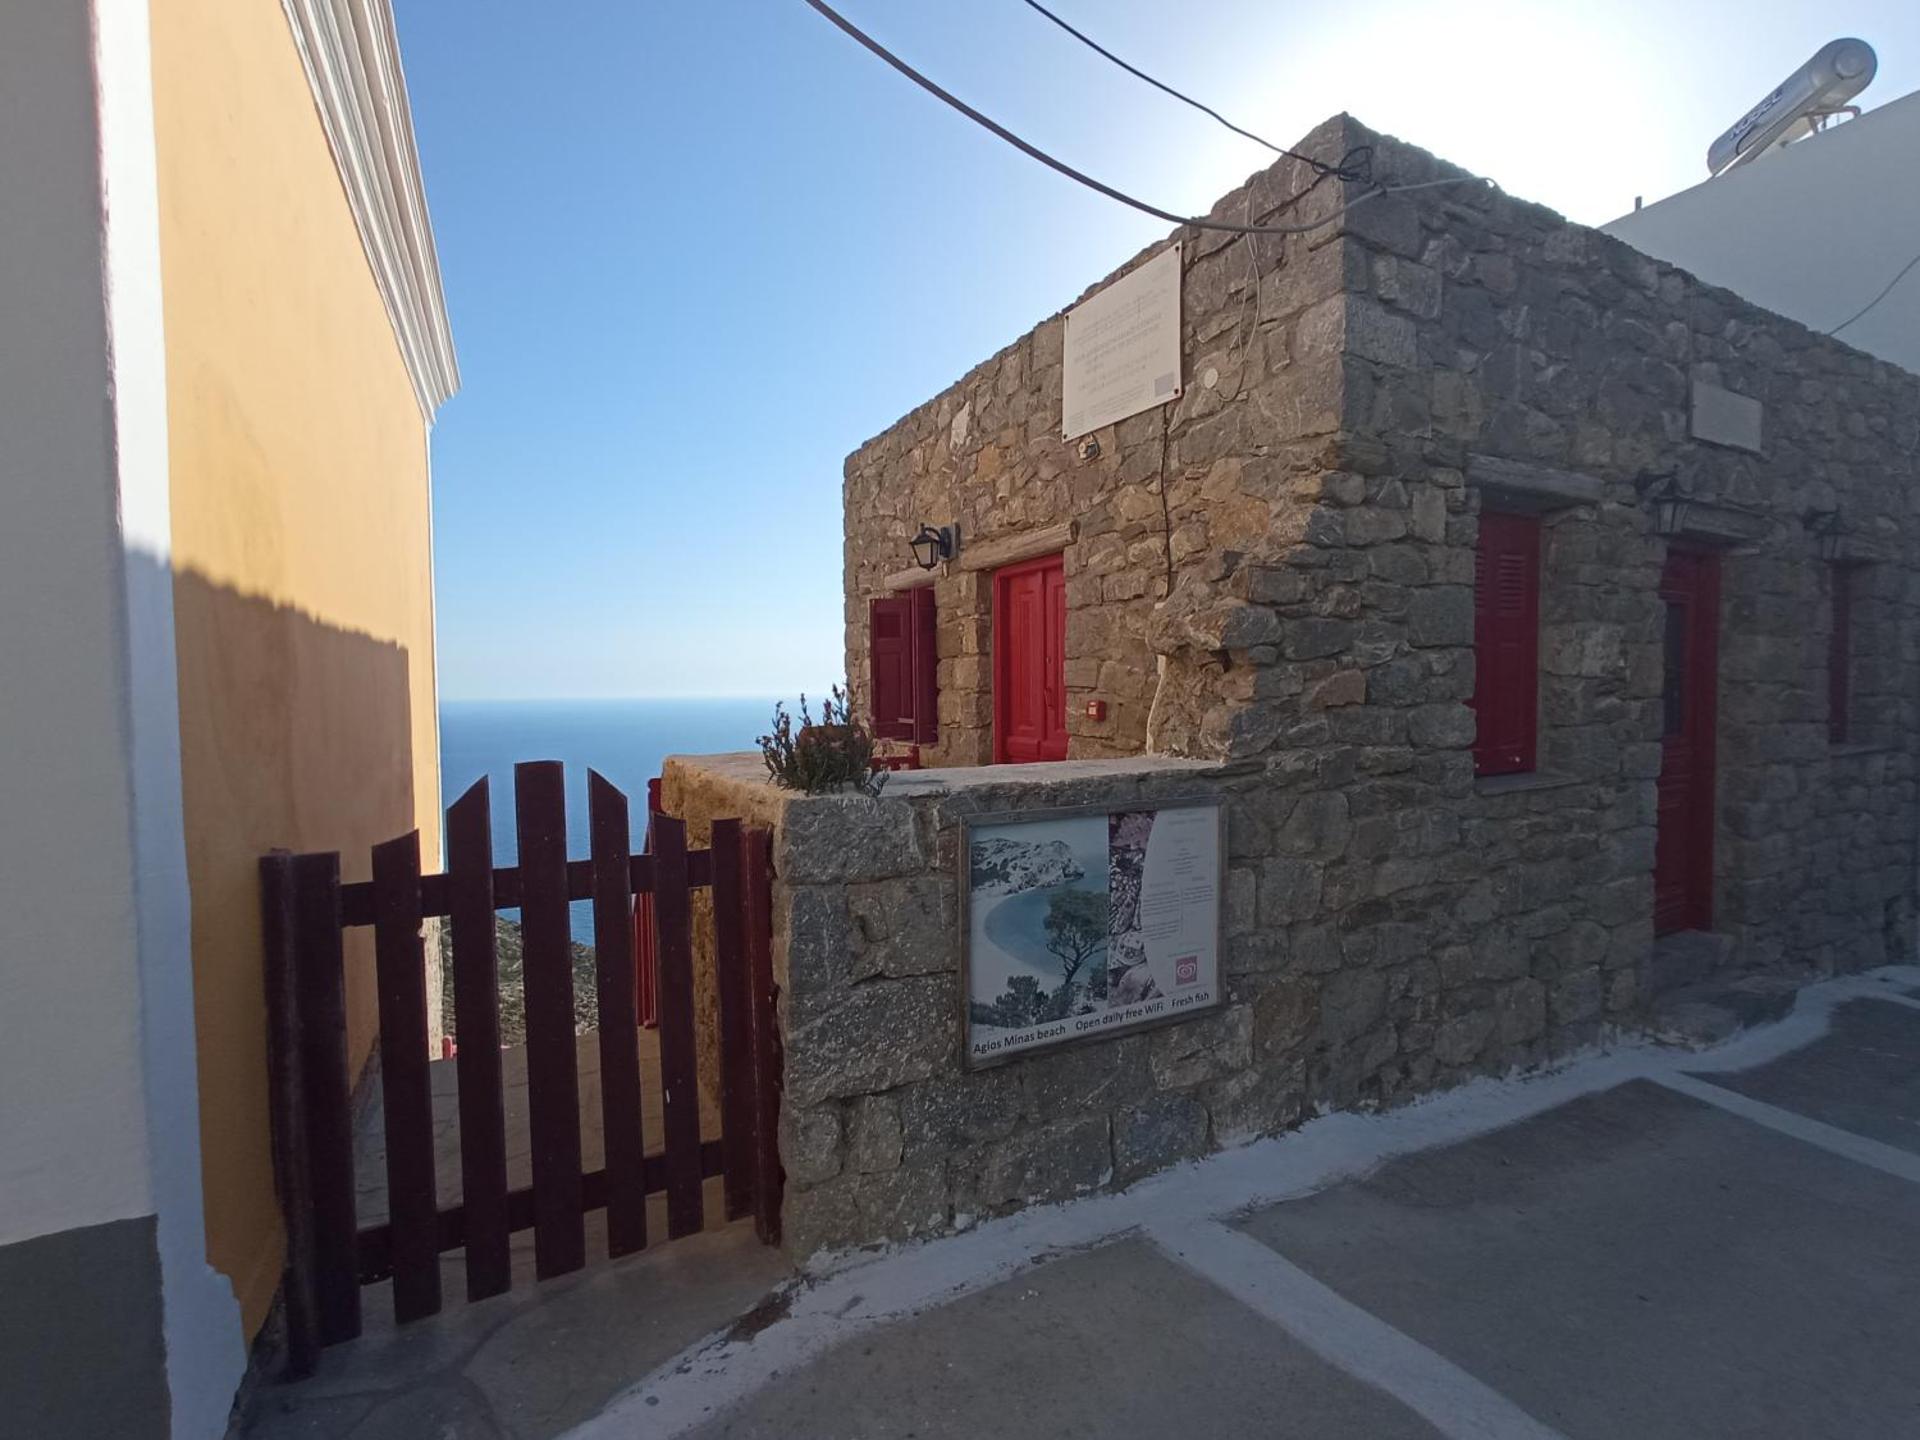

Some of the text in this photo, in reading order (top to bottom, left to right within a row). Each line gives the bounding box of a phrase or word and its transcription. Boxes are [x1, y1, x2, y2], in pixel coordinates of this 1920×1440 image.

[974, 992, 1209, 1055] Agios Minas beach Open daily free WiFi Fresh fish
